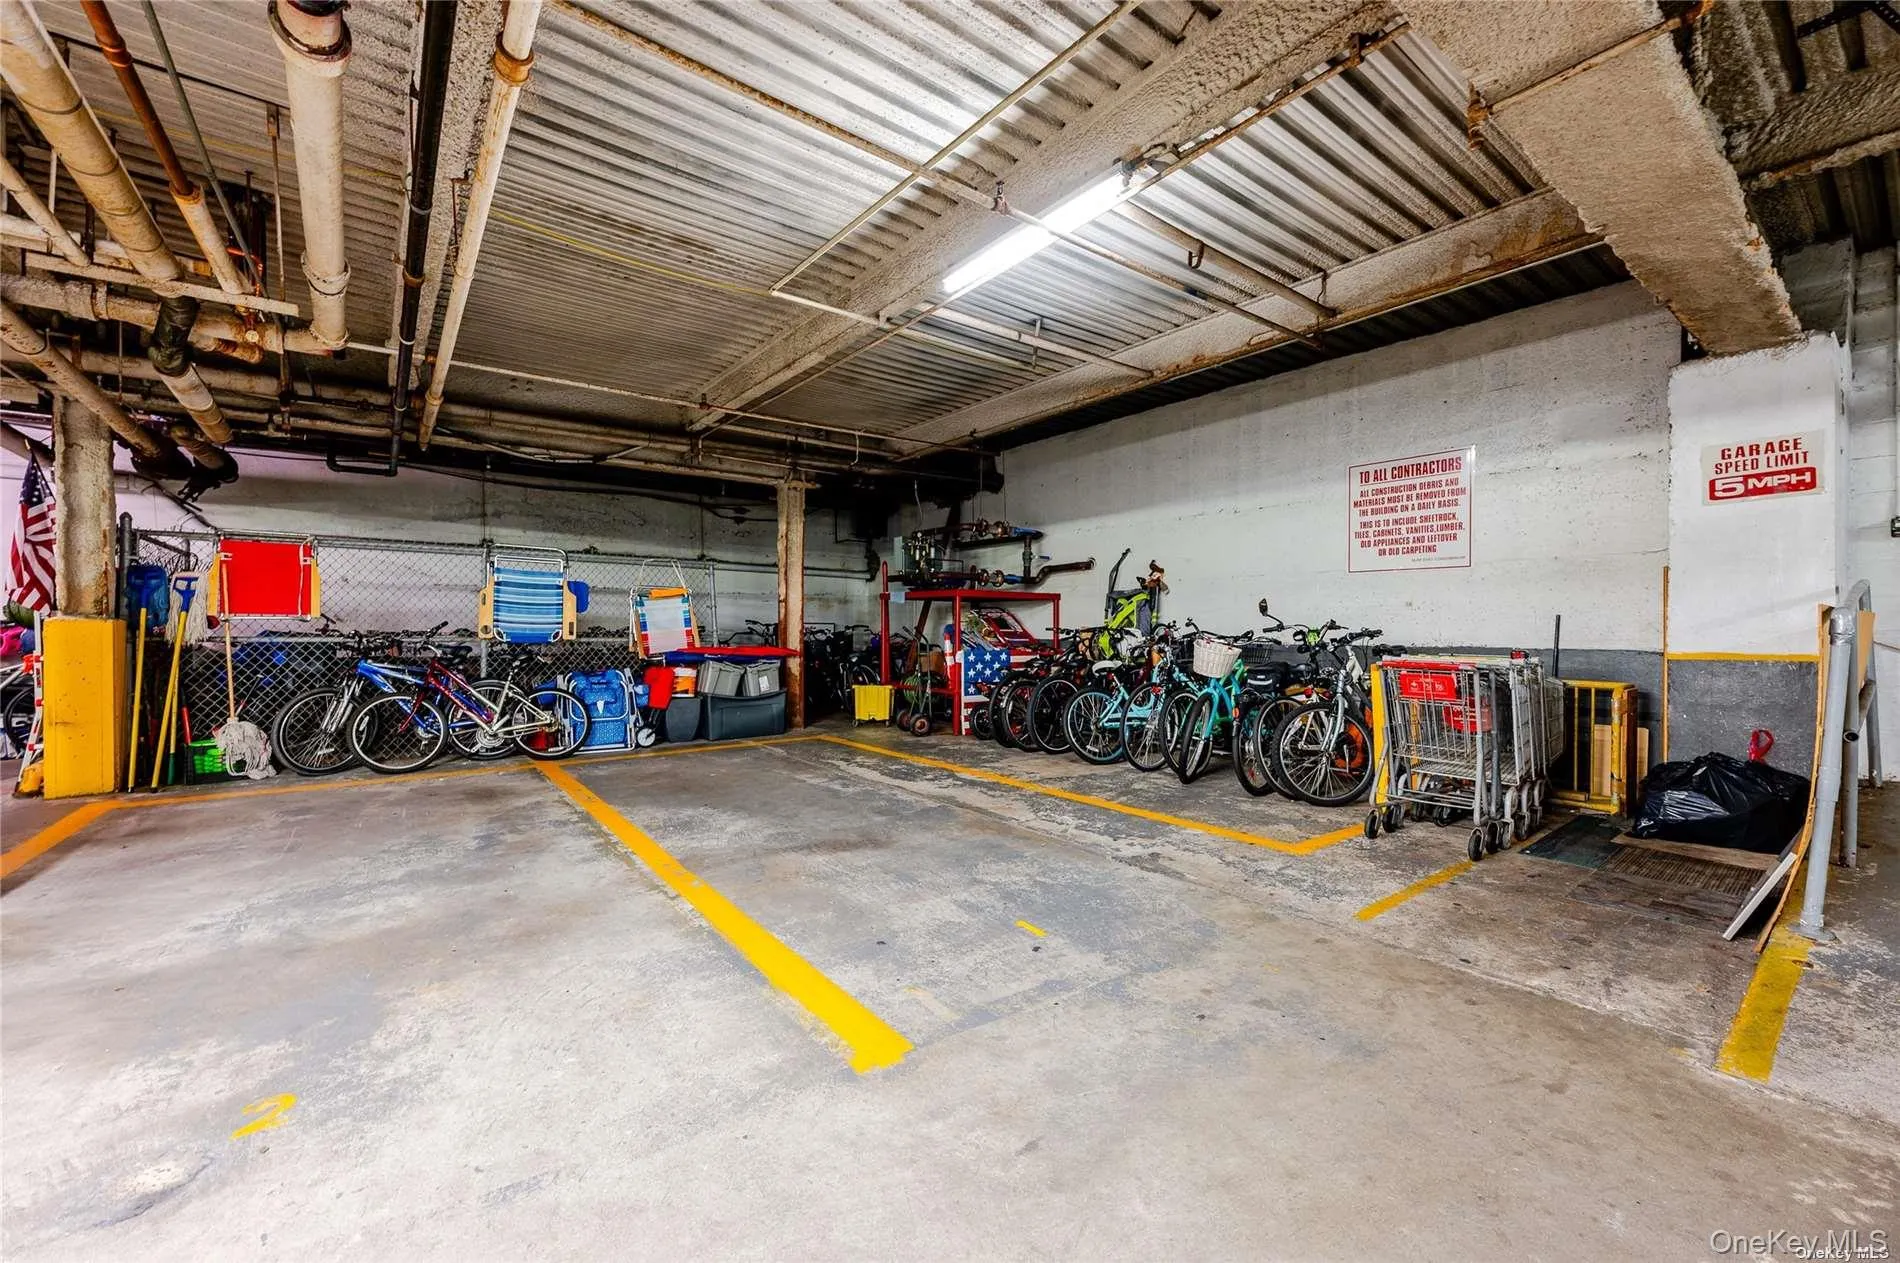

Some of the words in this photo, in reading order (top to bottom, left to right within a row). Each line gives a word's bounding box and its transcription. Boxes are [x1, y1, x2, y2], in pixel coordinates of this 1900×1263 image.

[1721, 437, 1802, 461] GARAGE
[1360, 471, 1370, 484] TO
[1373, 468, 1388, 482] ALL
[1391, 456, 1462, 480] CONTRACTORS
[1715, 458, 1759, 475] SPEED
[1767, 451, 1809, 468] LIMIT
[1360, 490, 1369, 498] ALL
[1371, 483, 1417, 497] CONSTRUCTION
[1419, 479, 1443, 491] DEBRIS
[1445, 477, 1459, 487] AND
[1714, 475, 1745, 497] 5
[1747, 471, 1811, 489] MPH
[1353, 497, 1386, 508] MATERIALS
[1387, 495, 1404, 504] MUST
[1406, 493, 1413, 502] BE
[1415, 489, 1446, 501] REMOVED
[1447, 487, 1467, 497] FROM
[1359, 508, 1369, 517] THE
[1370, 505, 1399, 516] BUILDING
[1400, 504, 1409, 513] ON
[1411, 503, 1416, 511] A
[1417, 501, 1436, 511] DAILY
[1360, 520, 1373, 529] THIS
[1374, 519, 1381, 528] IS
[1383, 518, 1391, 527] TO
[1391, 516, 1417, 526] INCLUDE
[1360, 540, 1372, 549] OLD
[1373, 536, 1410, 547] APPLIANCES
[1412, 535, 1426, 545] AND
[1427, 532, 1458, 543] LEFTOVER
[1378, 548, 1387, 557] OR
[1388, 547, 1400, 556] OLD
[1401, 544, 1437, 555] CARPETING
